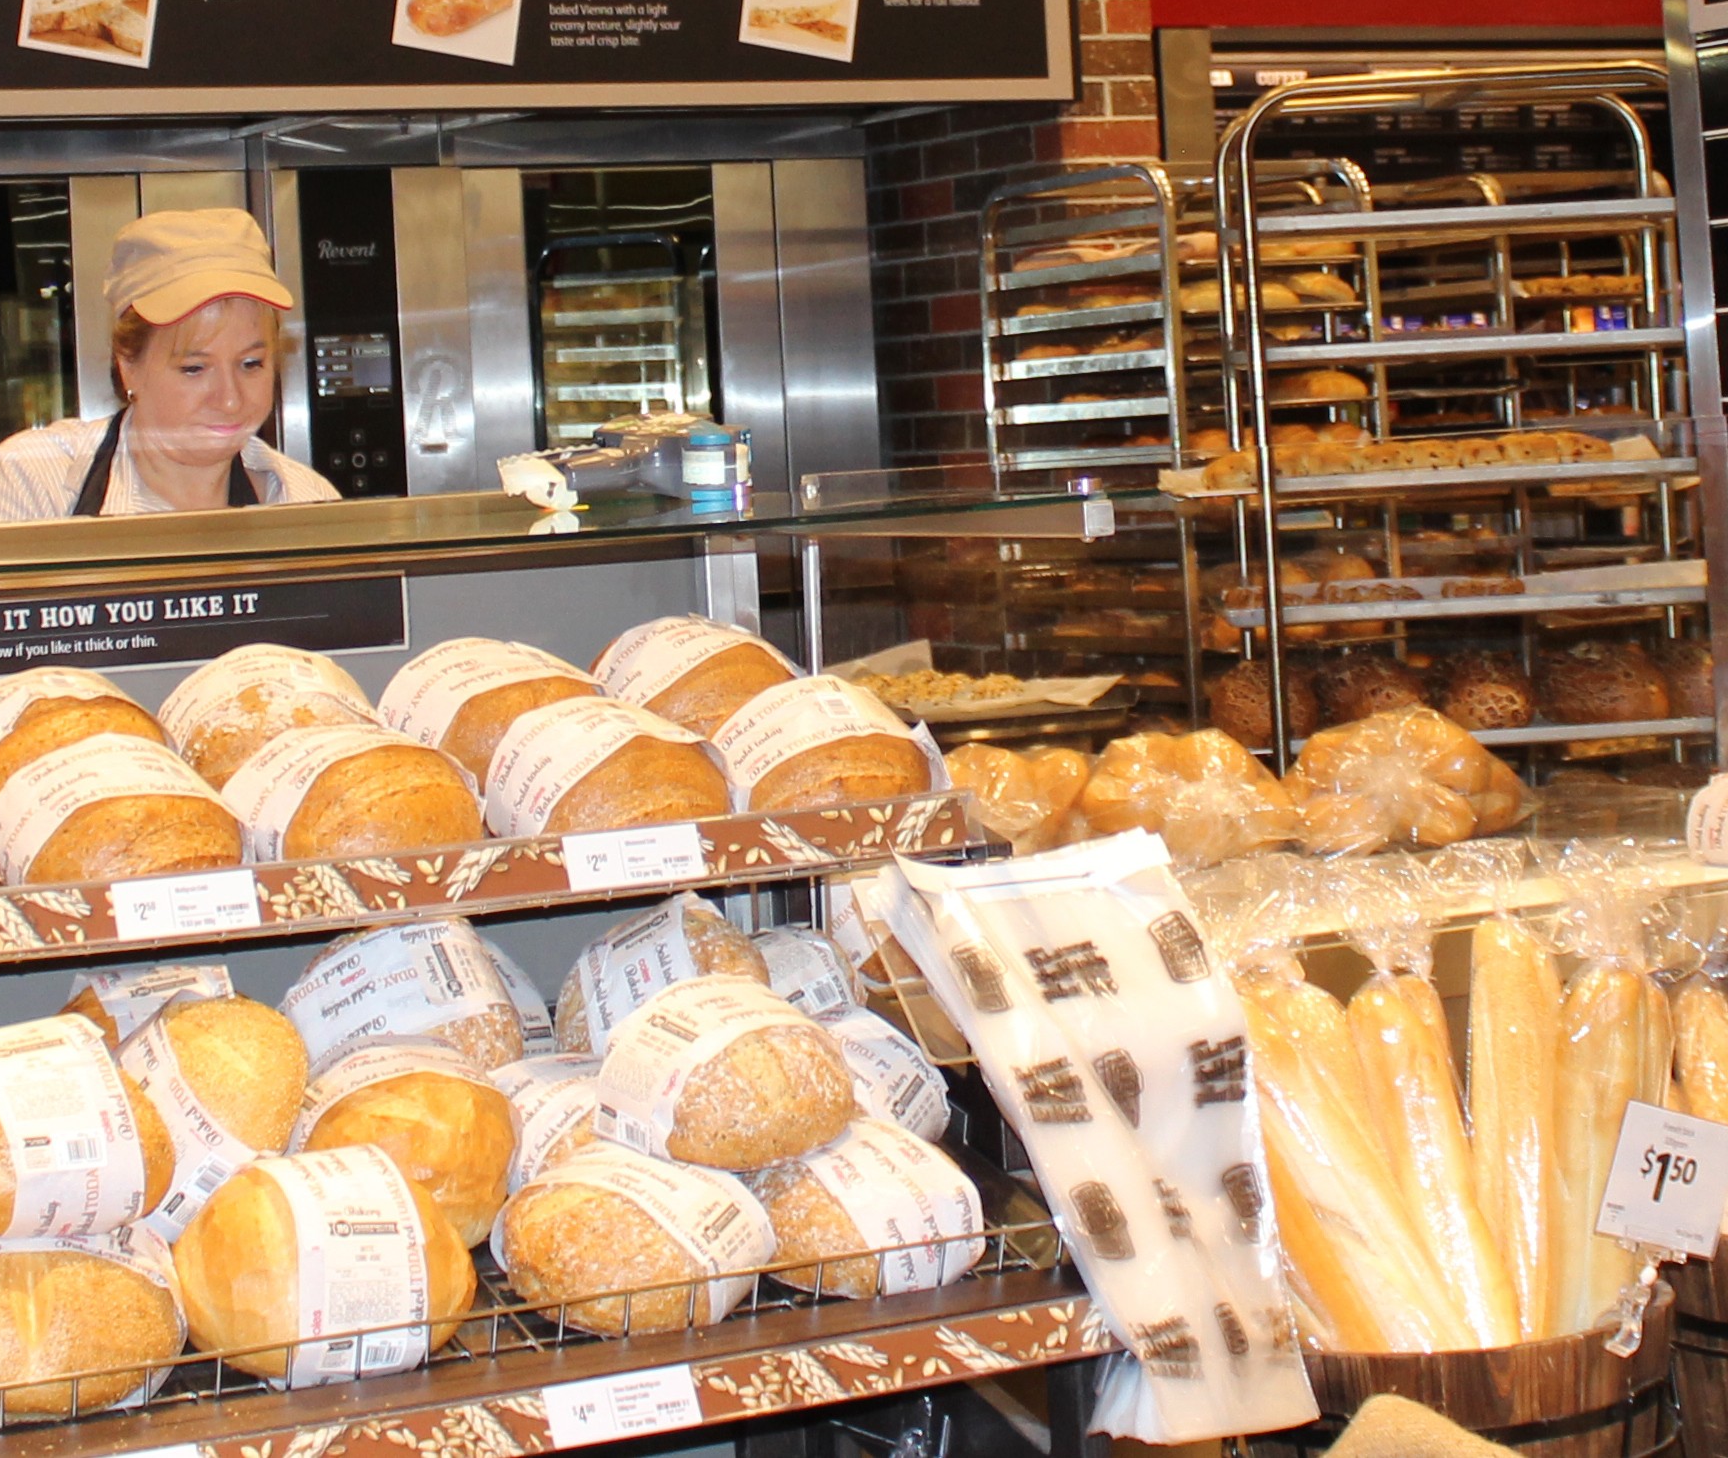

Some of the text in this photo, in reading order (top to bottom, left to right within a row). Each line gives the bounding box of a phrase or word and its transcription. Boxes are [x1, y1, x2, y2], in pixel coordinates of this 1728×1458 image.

[318, 239, 377, 260] Revent
[3, 609, 30, 631] IT
[40, 603, 96, 629] HOW
[105, 600, 154, 623] YOU
[163, 595, 224, 620] LIKE
[232, 593, 259, 615] IT
[15, 642, 24, 657] if
[26, 644, 48, 660] you
[51, 640, 71, 654] like
[74, 639, 82, 653] it
[85, 637, 114, 652] thick
[116, 638, 129, 649] or
[131, 634, 157, 649] thin.
